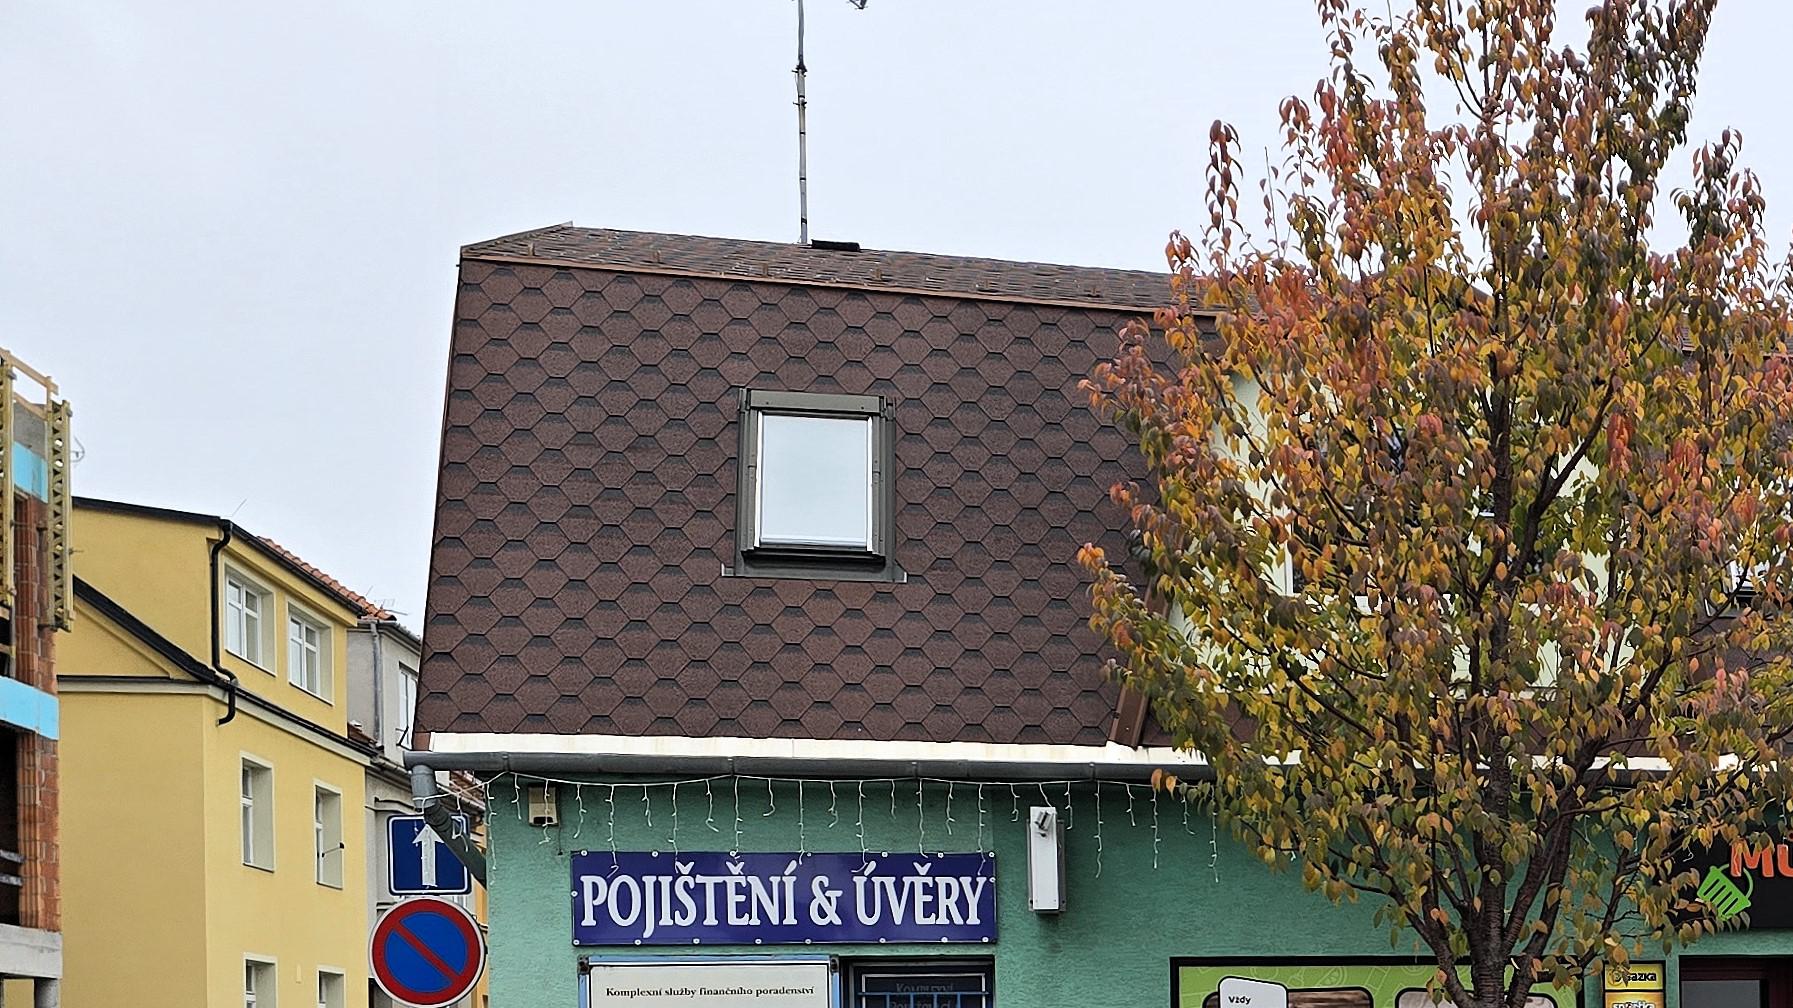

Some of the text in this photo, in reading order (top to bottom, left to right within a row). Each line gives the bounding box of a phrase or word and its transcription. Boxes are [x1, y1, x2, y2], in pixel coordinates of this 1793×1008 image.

[580, 860, 986, 938] POJIŠTĚNÍ & ÚVĚRY
[606, 986, 815, 998] Komplexní služby finančního poradenství
[1228, 996, 1251, 1005] Vždy
